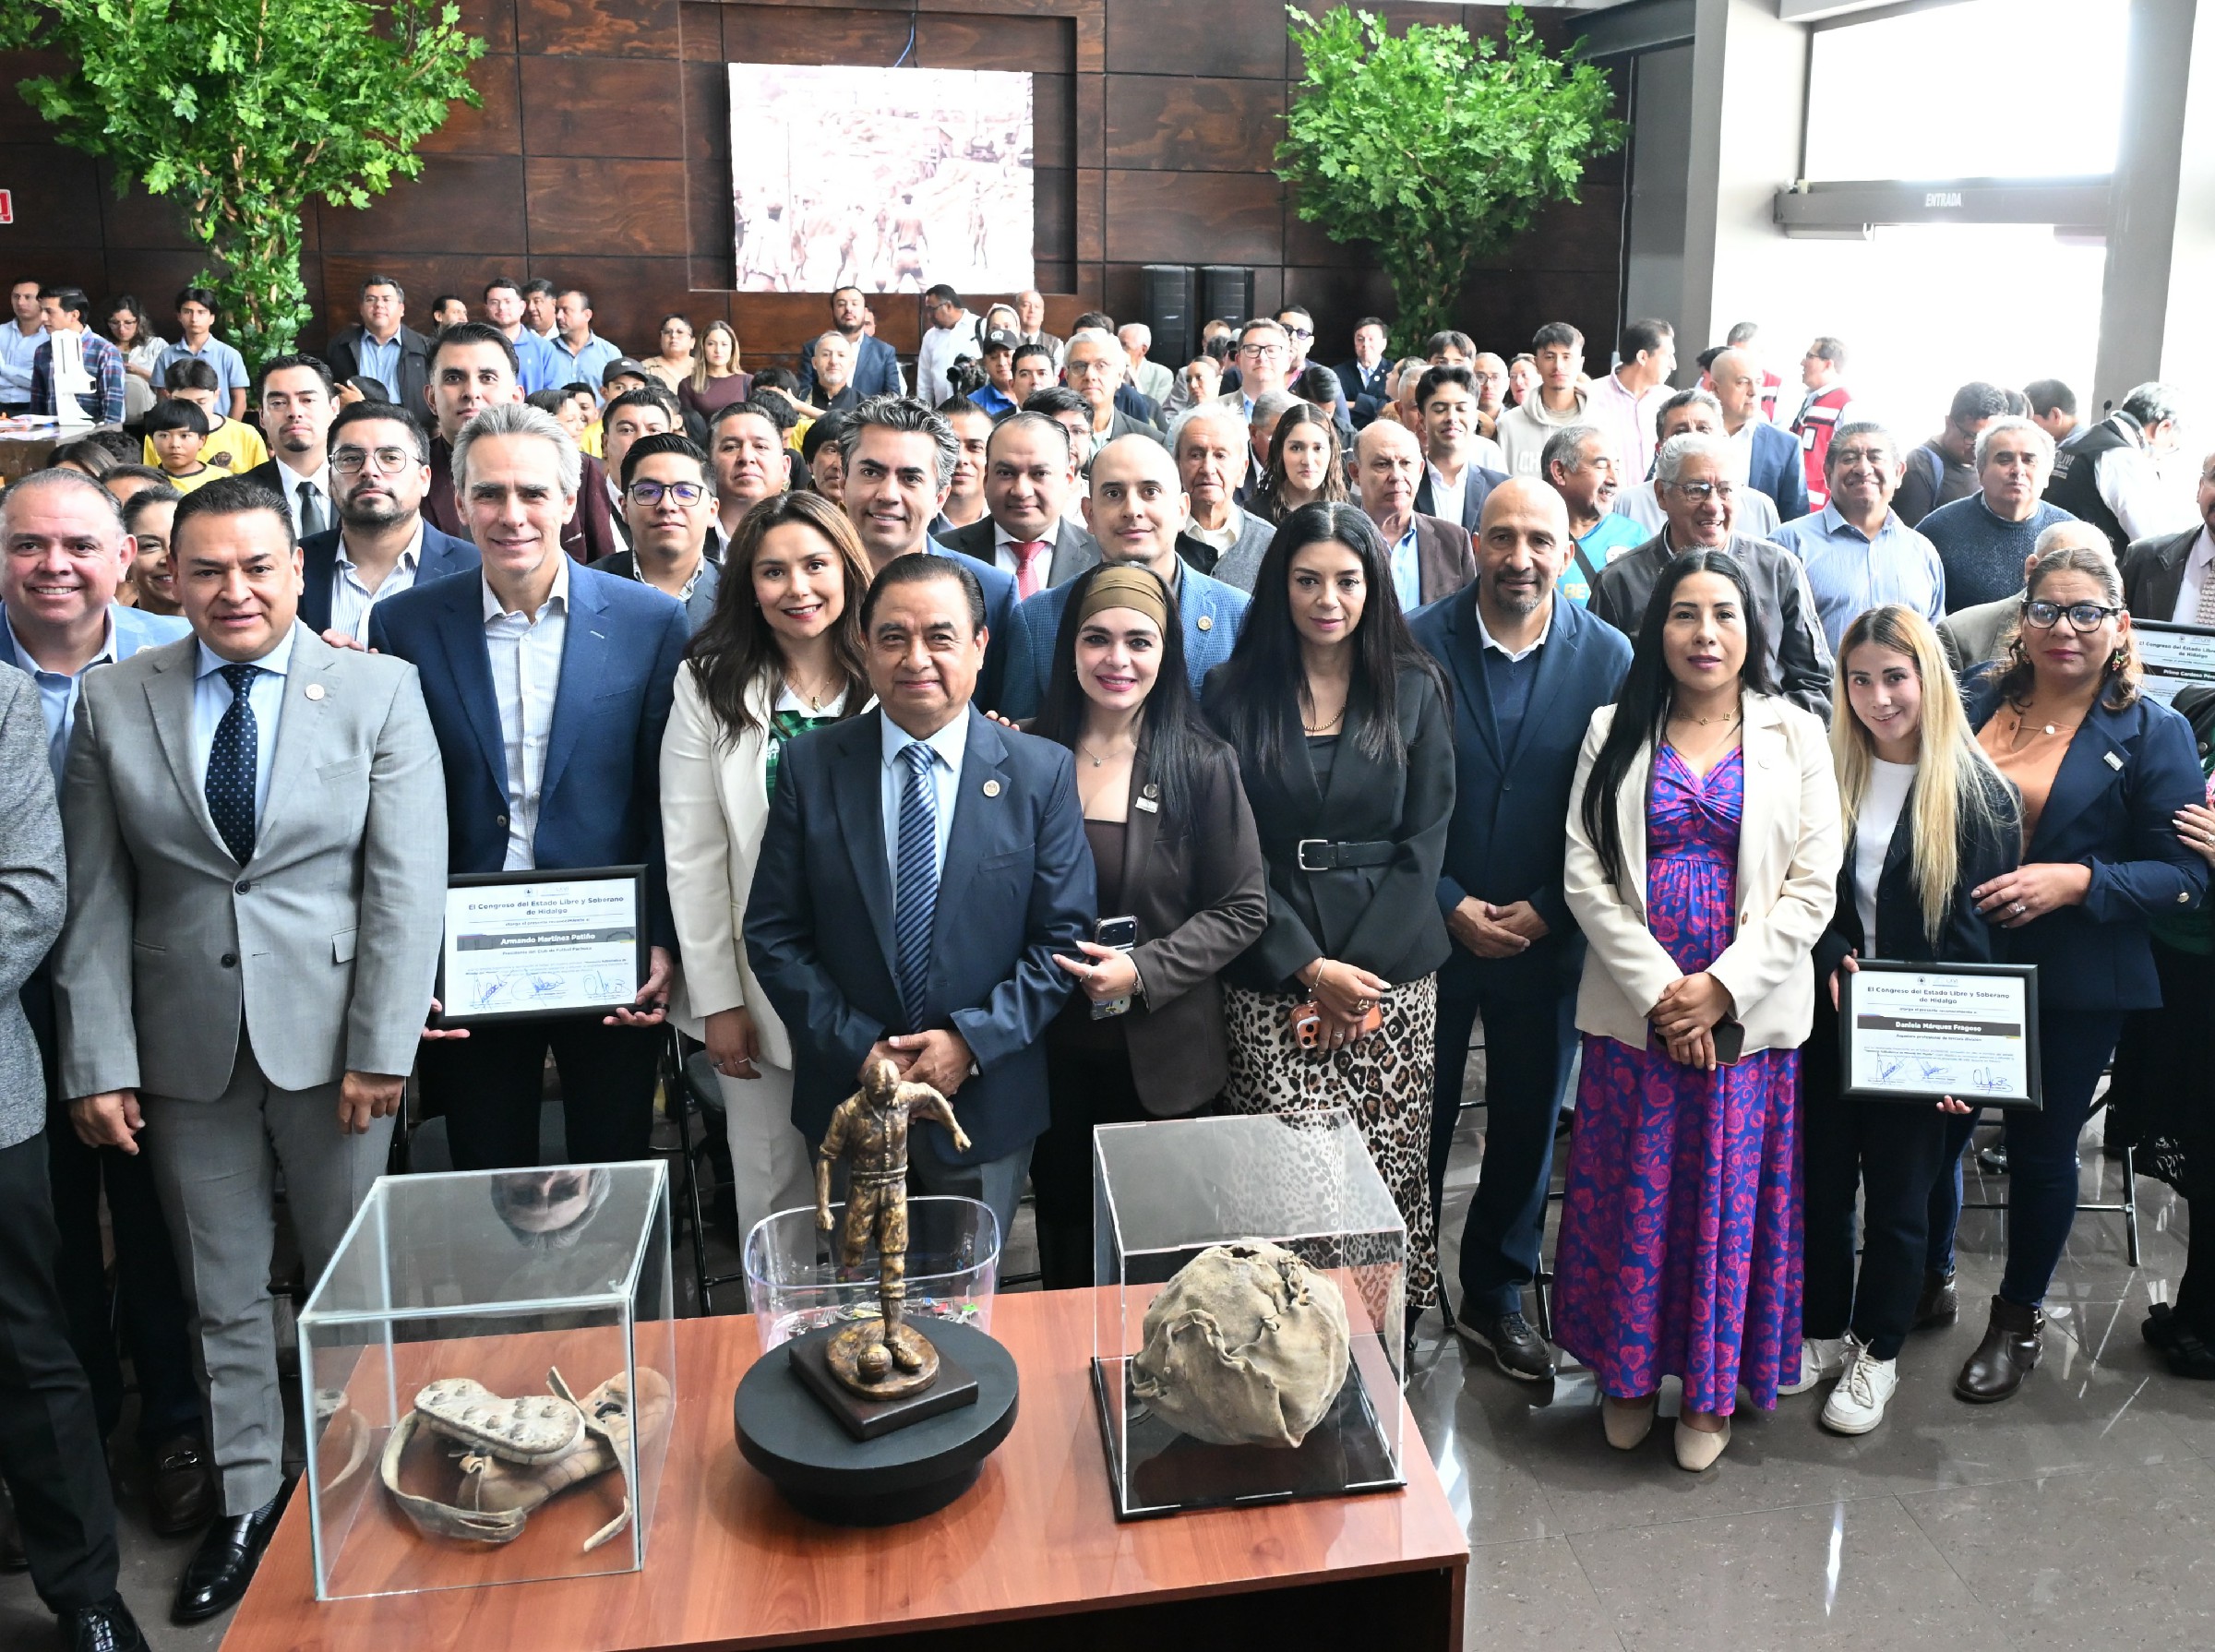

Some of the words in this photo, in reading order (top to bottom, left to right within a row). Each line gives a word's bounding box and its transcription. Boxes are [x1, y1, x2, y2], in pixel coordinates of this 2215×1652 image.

[1925, 192, 1962, 208] ENTRADA
[1518, 450, 1541, 473] CH
[1563, 582, 1586, 600] BE
[531, 899, 557, 907] Estado
[500, 937, 536, 945] Armando
[537, 934, 569, 943] Martínez
[1895, 1021, 1922, 1029] Daniela
[1922, 1023, 1952, 1031] Márquez
[1953, 1024, 1982, 1033] Fragoso
